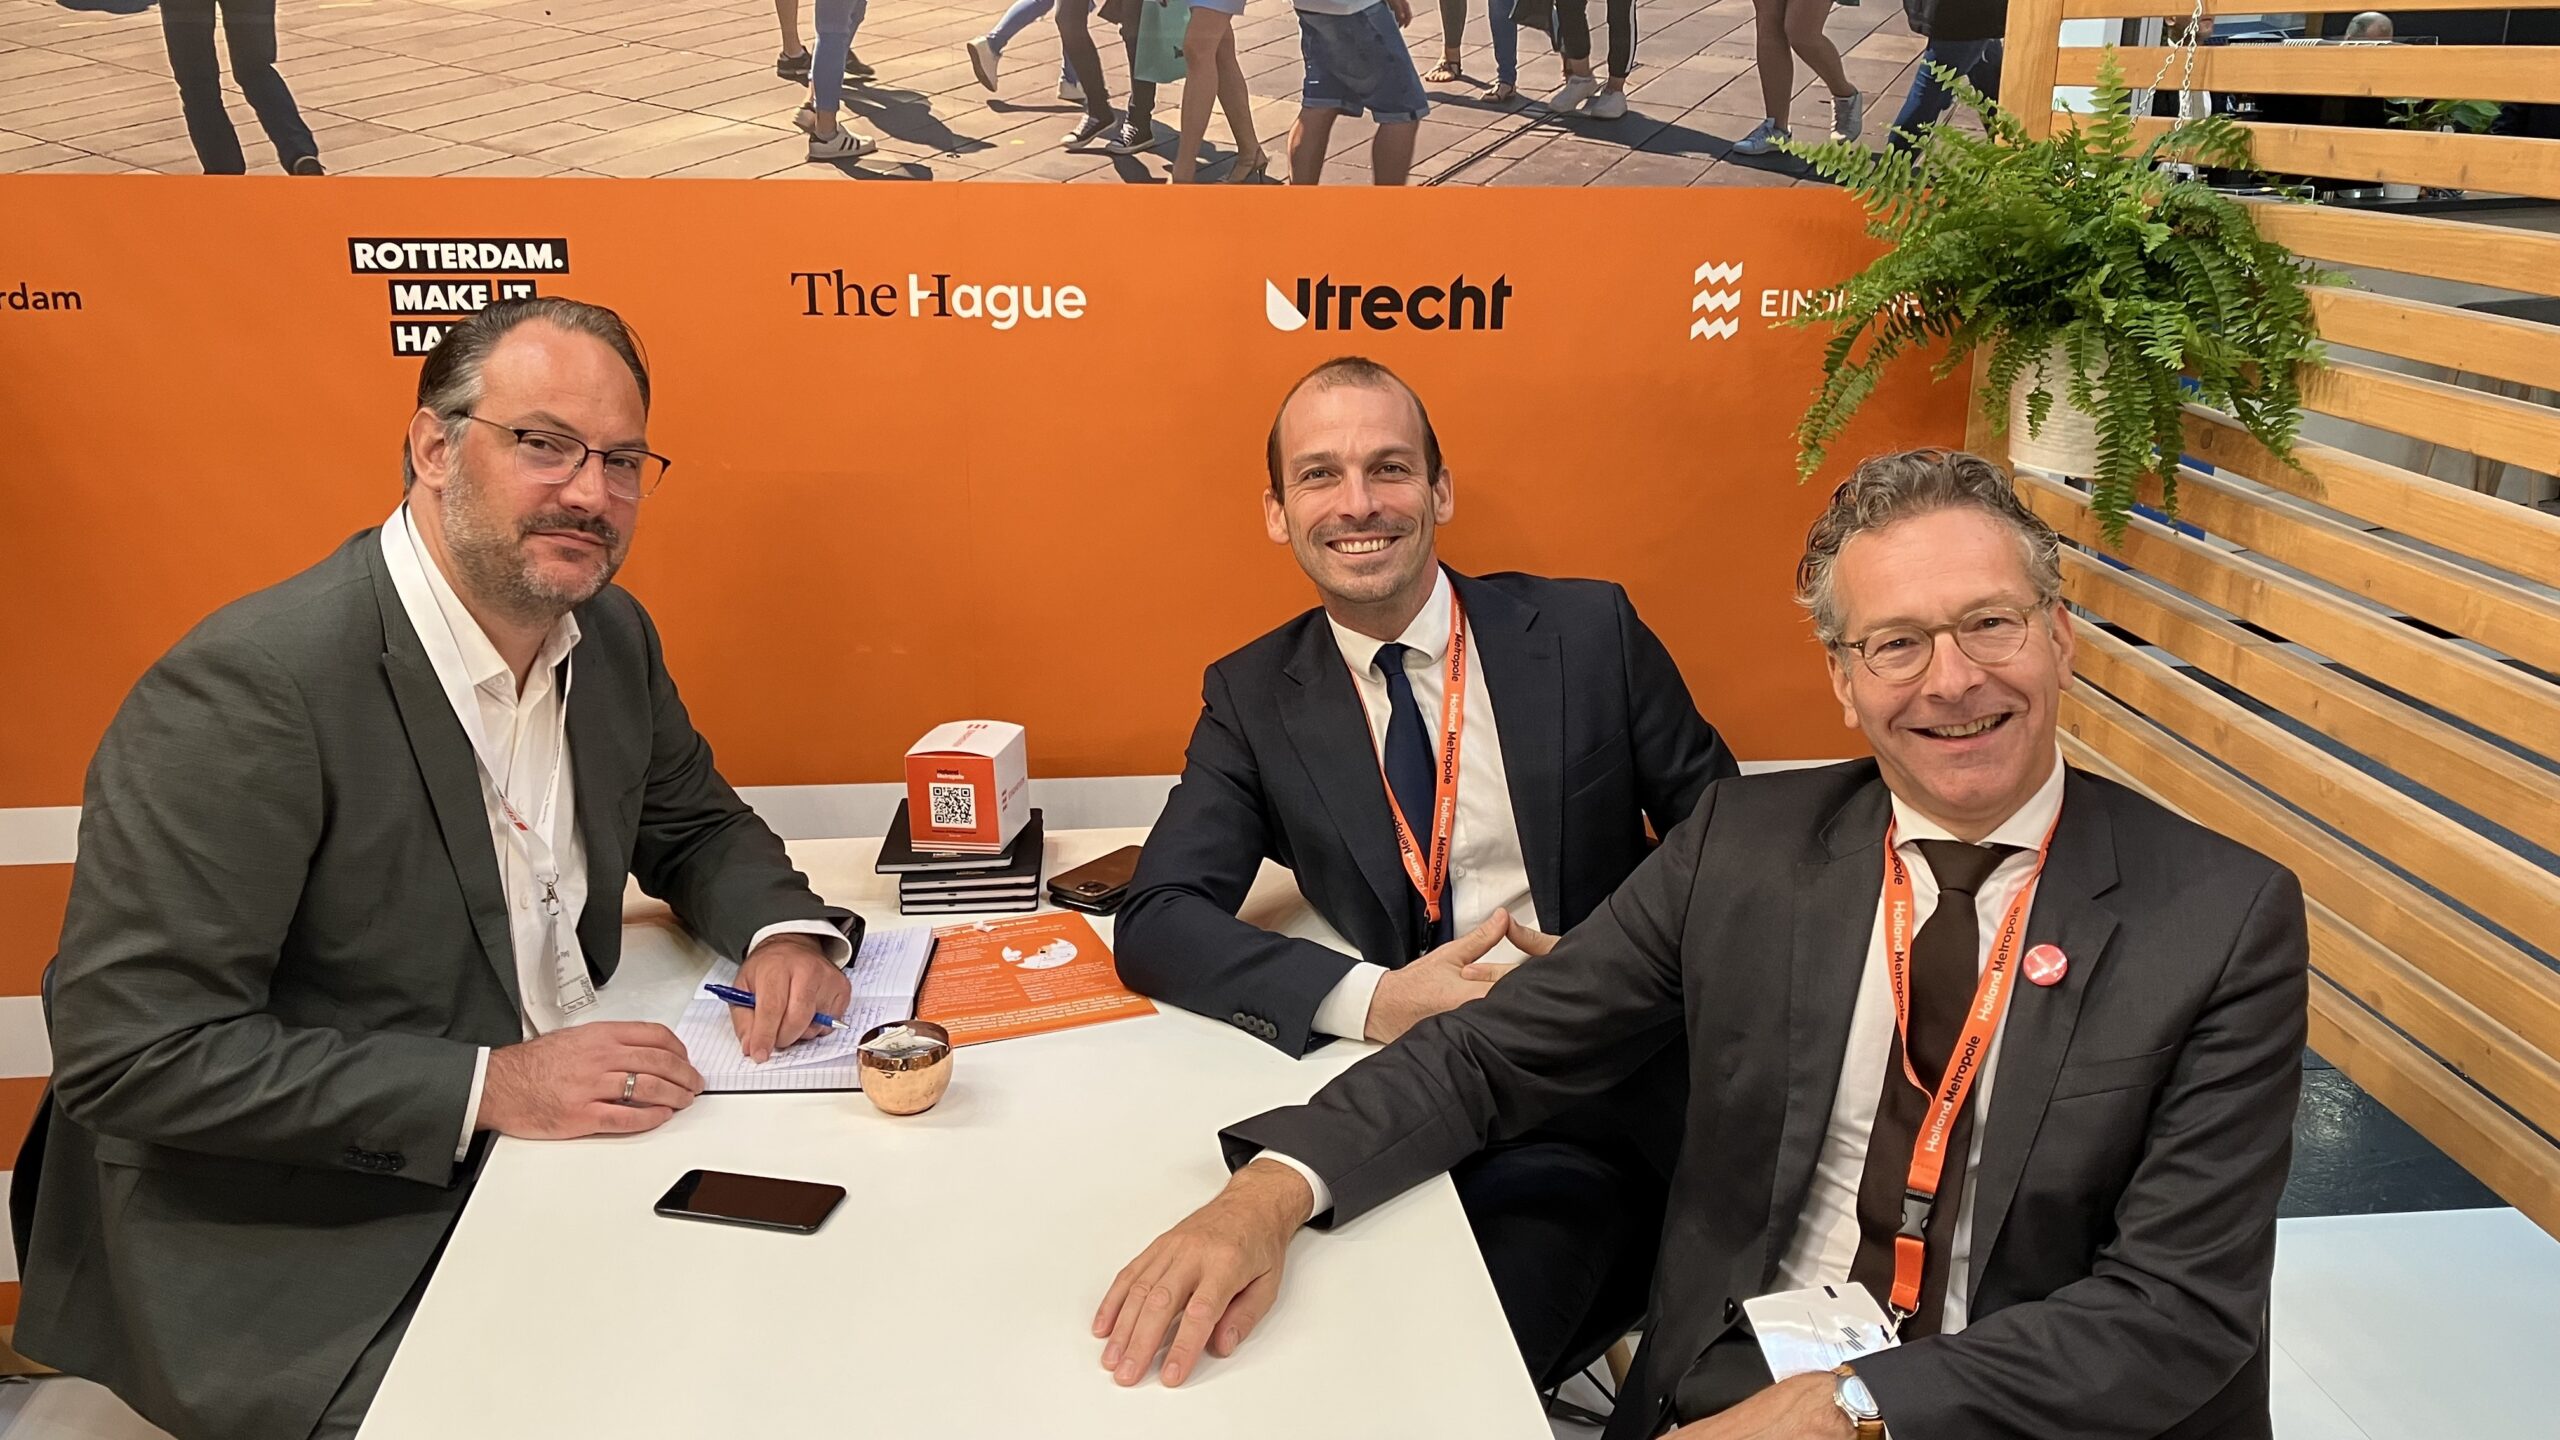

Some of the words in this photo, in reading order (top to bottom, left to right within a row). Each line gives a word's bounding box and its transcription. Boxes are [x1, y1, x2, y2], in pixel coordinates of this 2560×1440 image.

[354, 242, 564, 270] ROTTERDAM.
[394, 284, 489, 311] MAKE
[791, 269, 898, 317] The
[907, 272, 1087, 331] Hague
[1265, 272, 1513, 332] Utrecht
[396, 325, 452, 351] HA
